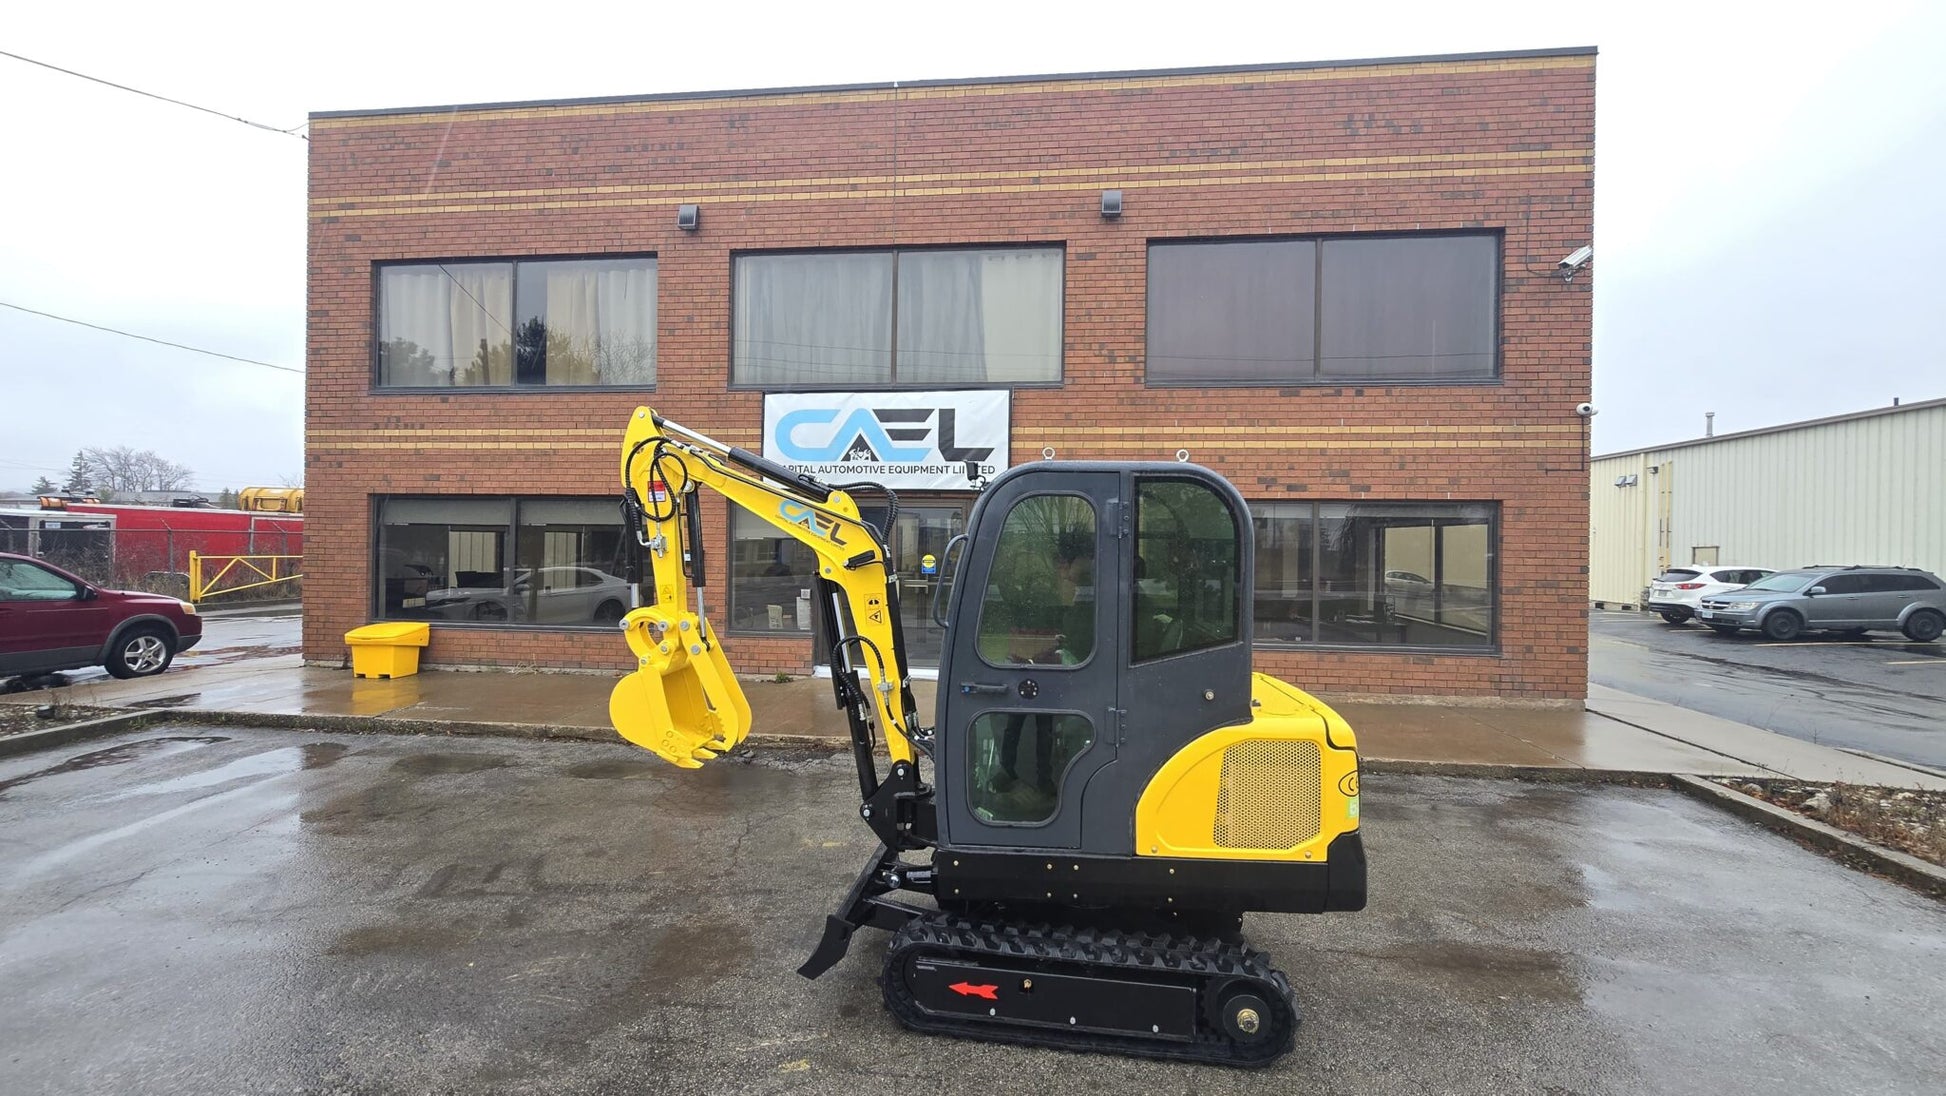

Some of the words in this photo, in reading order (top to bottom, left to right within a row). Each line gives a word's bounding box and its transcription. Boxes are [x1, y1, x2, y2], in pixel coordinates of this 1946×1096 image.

[775, 408, 995, 462] CAEL
[782, 465, 816, 474] PITAL
[818, 465, 886, 474] AUTOMOTIVE
[888, 465, 951, 475] EQUIPMENT
[952, 465, 996, 475] LIED
